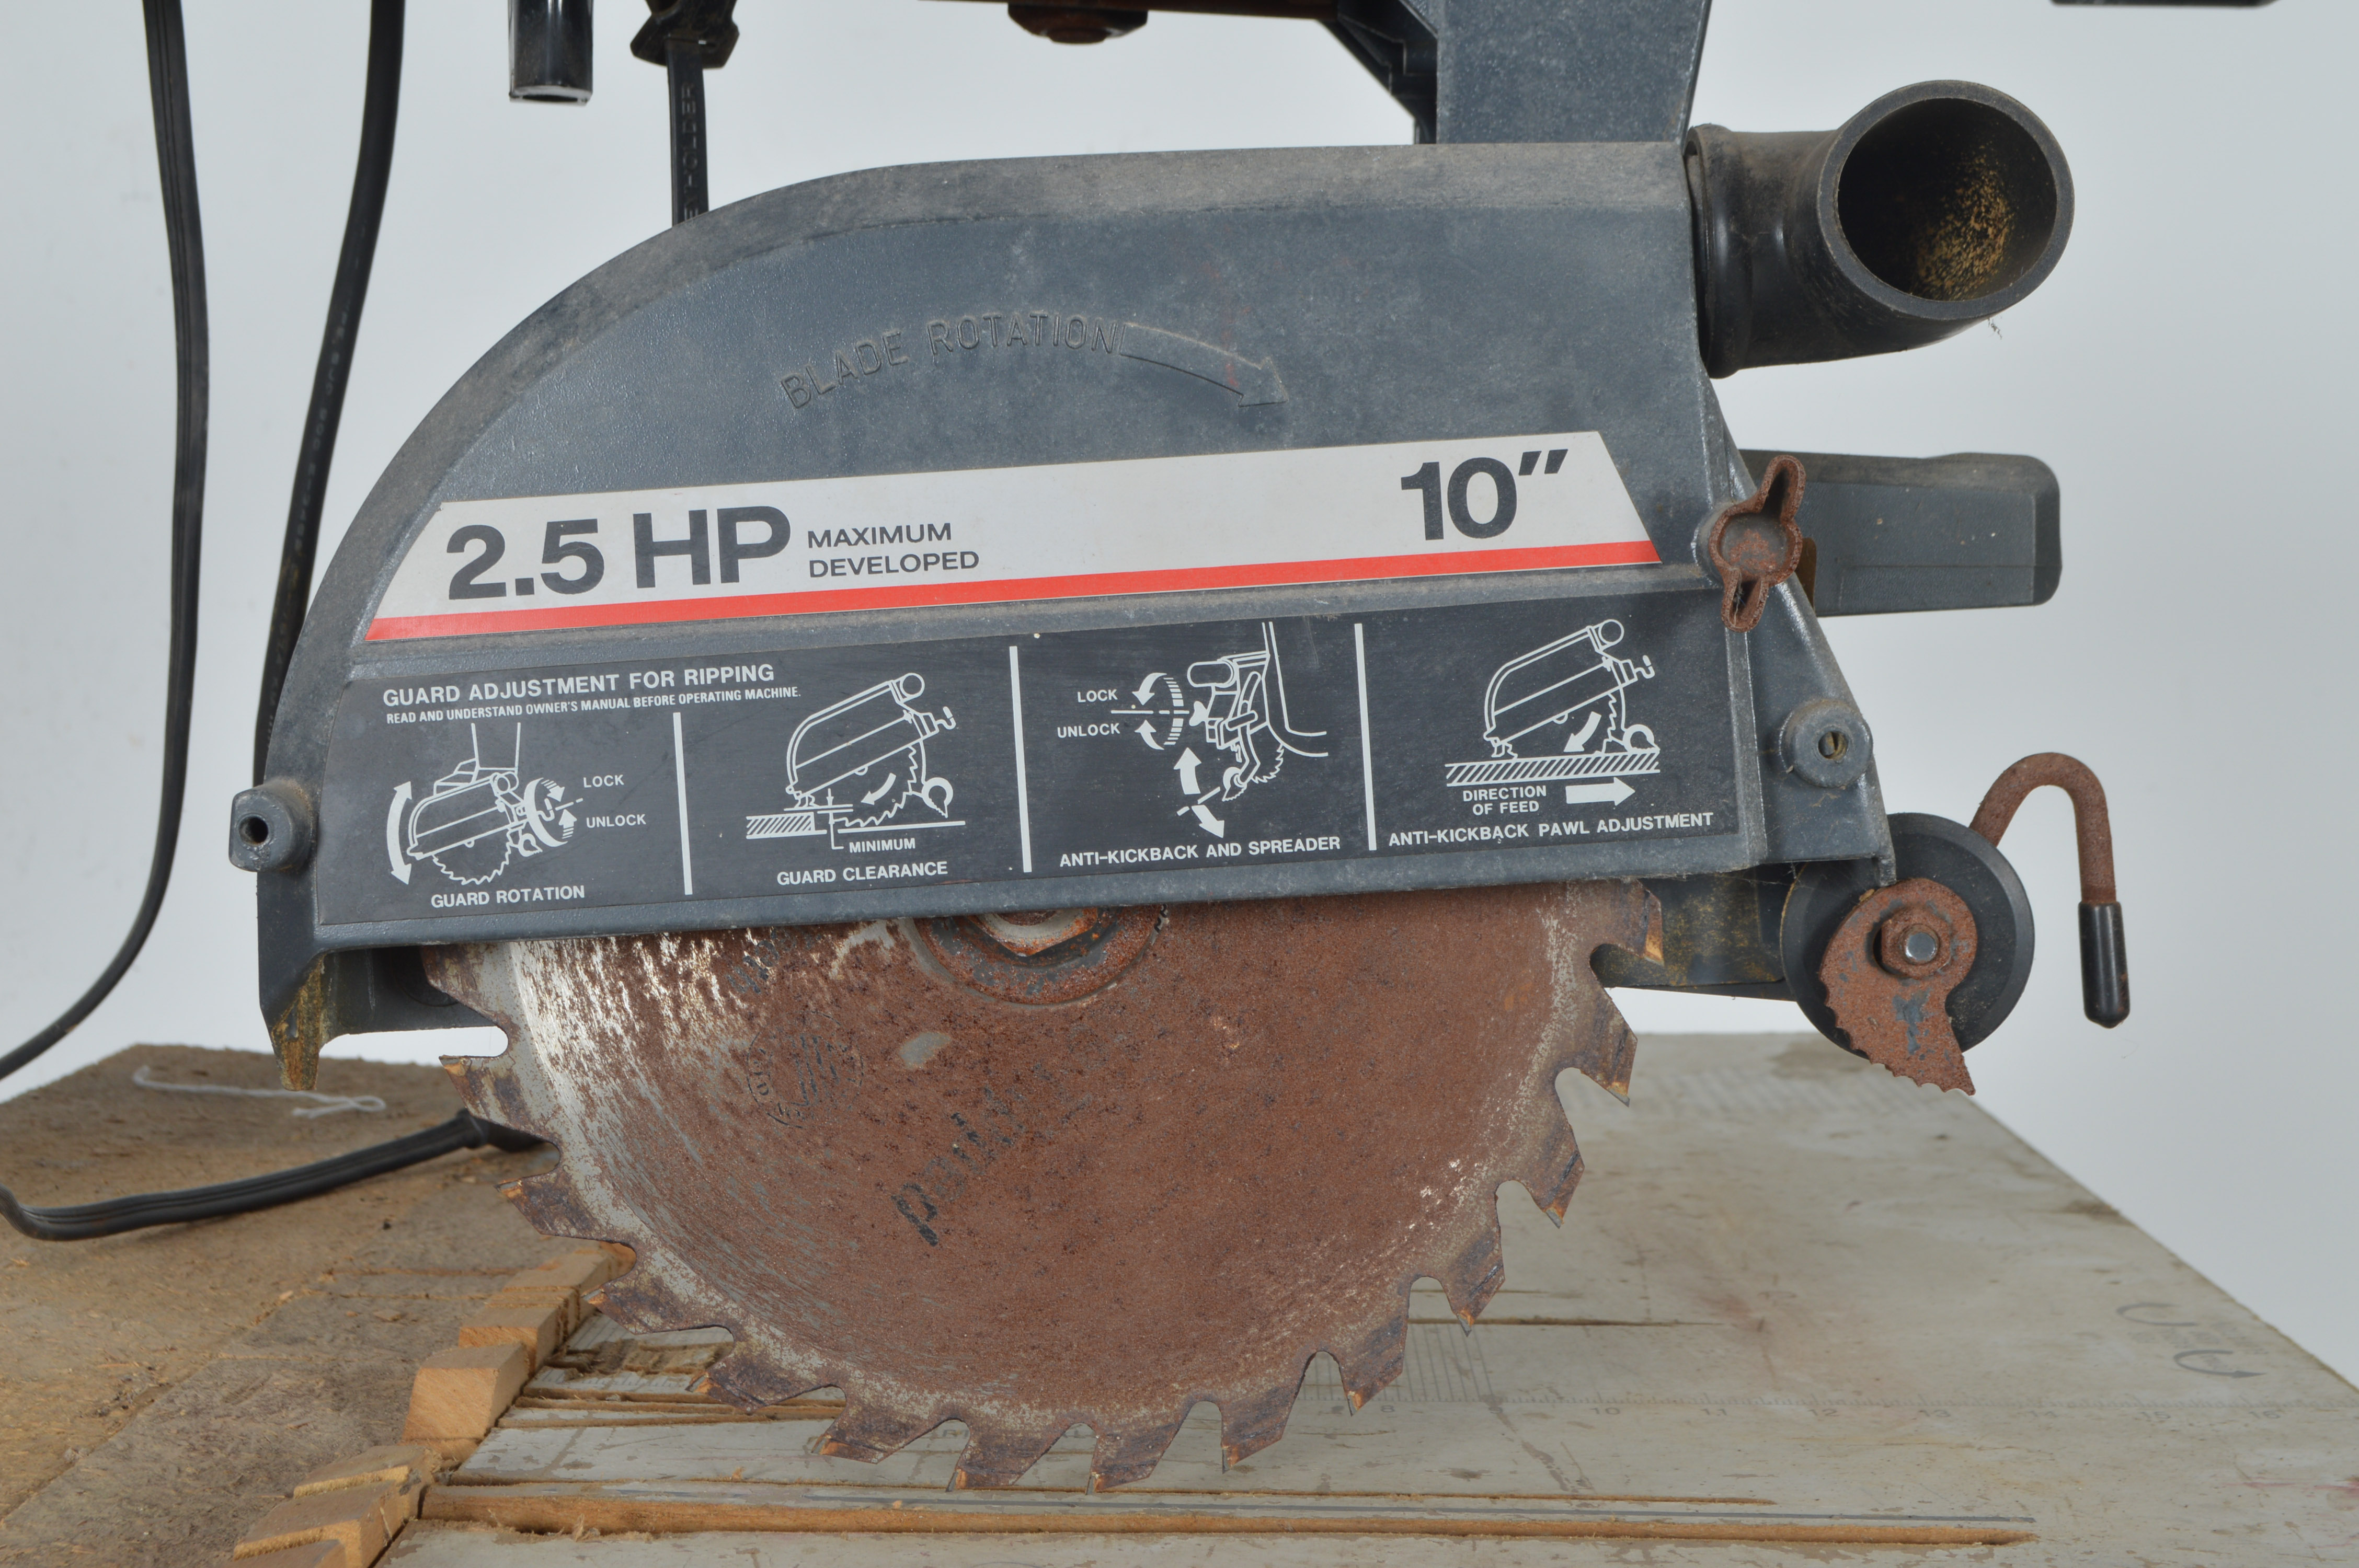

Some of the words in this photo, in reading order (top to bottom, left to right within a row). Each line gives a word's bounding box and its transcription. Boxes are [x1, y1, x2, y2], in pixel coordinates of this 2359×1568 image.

[780, 329, 909, 410] BLADE
[926, 312, 1118, 358] ROTATION
[808, 523, 951, 548] MAXIMUM
[447, 519, 604, 599] 2.5
[633, 506, 791, 588] HP
[809, 550, 979, 578] DEVELOPED
[384, 686, 460, 706] GUARD
[469, 674, 620, 699] ADJUSTMENT
[630, 671, 674, 689] FOR
[684, 664, 774, 685] RIPPING
[1078, 689, 1117, 702] LOCK
[387, 712, 416, 723] READ
[420, 711, 443, 721] AND
[447, 705, 522, 720] UNDERSTAND
[526, 701, 578, 714] OWNER'S
[581, 698, 630, 710] MANUAL
[634, 695, 675, 707] BEFORE
[679, 690, 741, 704] OPERATING
[745, 686, 801, 700] MACHINE.
[1058, 723, 1120, 738] UNLOCK
[583, 775, 624, 788] LOCK
[1463, 786, 1547, 802] DIRECTION
[1472, 804, 1493, 815] OF
[1500, 801, 1539, 813] FEED
[587, 814, 646, 828] UNLOCK
[1389, 824, 1529, 846] ANTI-KICKBACK
[1539, 821, 1589, 836] PAWL
[1597, 812, 1713, 833] ADJUSTMENT
[850, 838, 915, 852] MINIMUM
[1060, 845, 1198, 867] ANTI-KICKBACK
[1206, 843, 1241, 857] AND
[1249, 837, 1340, 855] SPREADER
[777, 869, 835, 885] GUARD
[843, 861, 947, 881] CLEARANCE
[431, 892, 489, 907] GUARD
[497, 885, 584, 903] ROTATION
[1380, 1404, 1395, 1413] 8
[1590, 1407, 1620, 1415] 10
[2140, 1411, 2171, 1420] 15
[2248, 1411, 2281, 1420] 16
